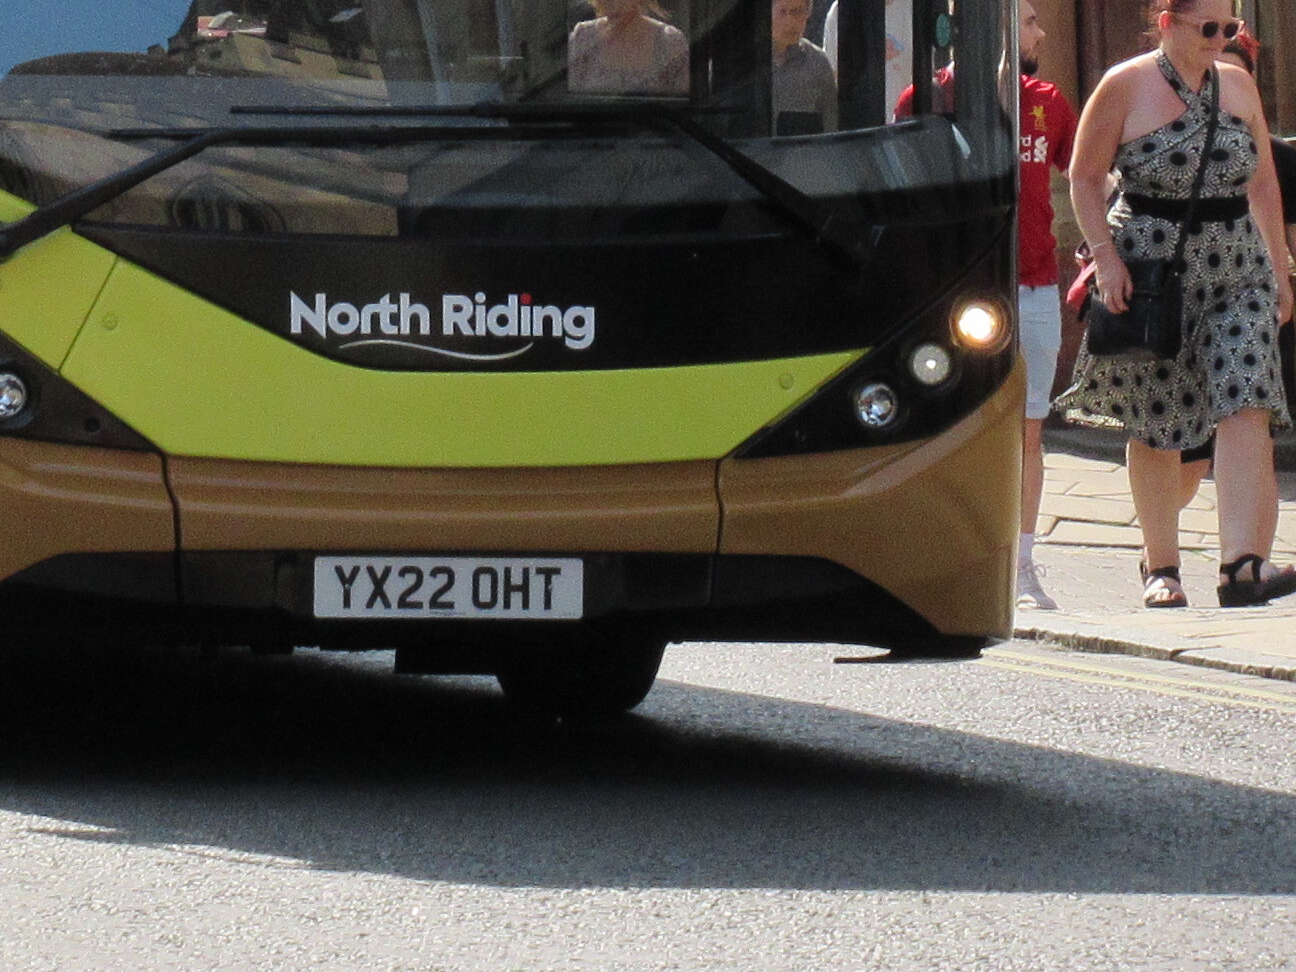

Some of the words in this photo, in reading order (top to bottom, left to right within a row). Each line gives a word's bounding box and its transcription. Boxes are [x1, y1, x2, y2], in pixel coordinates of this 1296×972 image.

[290, 290, 431, 339] North
[442, 291, 596, 350] Riding
[334, 564, 455, 610] YX22
[471, 565, 561, 610] OHT
